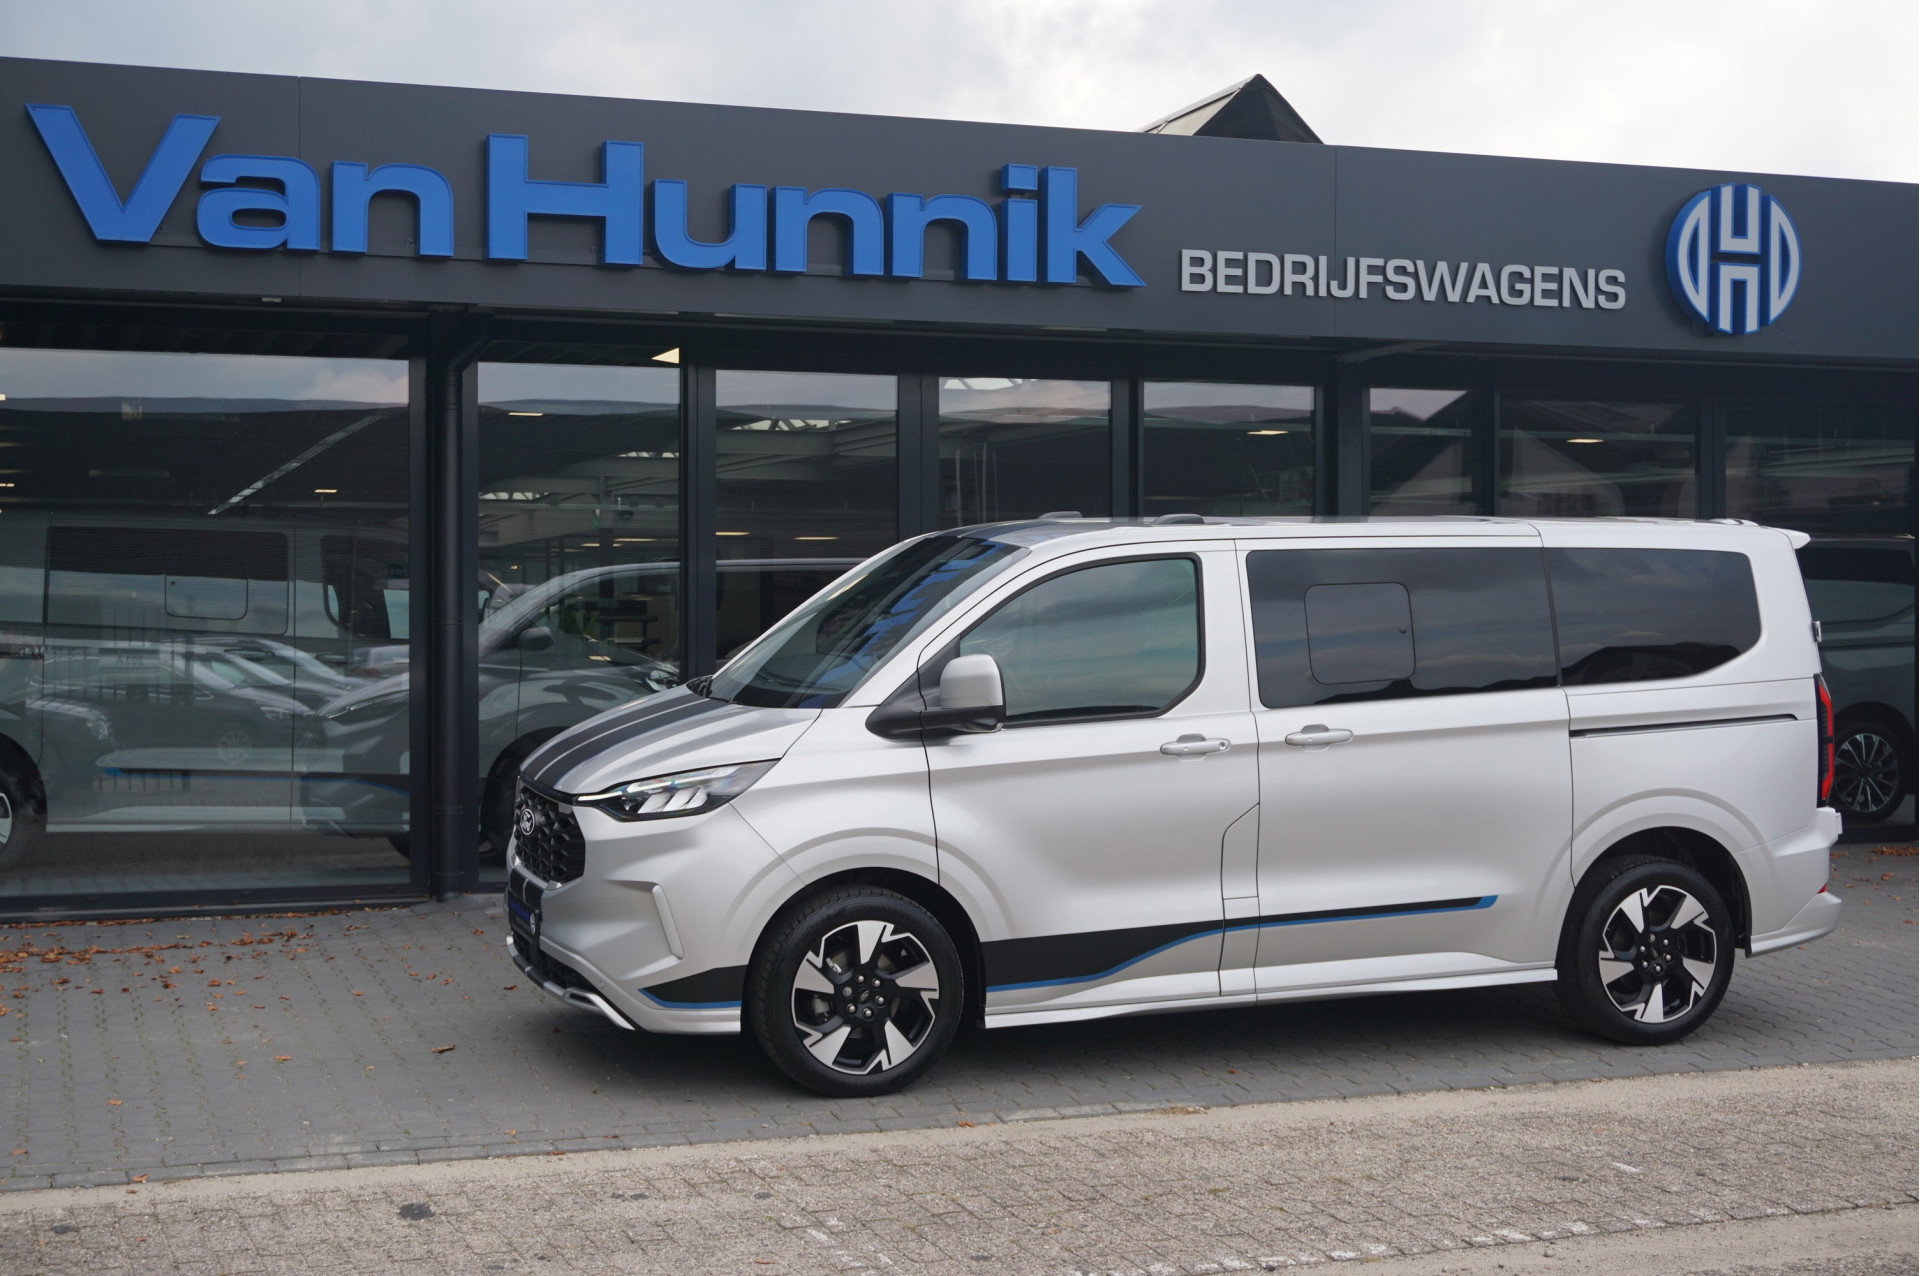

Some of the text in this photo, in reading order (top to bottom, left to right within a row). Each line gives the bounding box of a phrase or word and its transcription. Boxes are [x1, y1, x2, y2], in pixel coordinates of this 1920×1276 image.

[25, 103, 1146, 288] Van Hunnik
[1179, 249, 1627, 310] BEDRIJFSWAGENS
